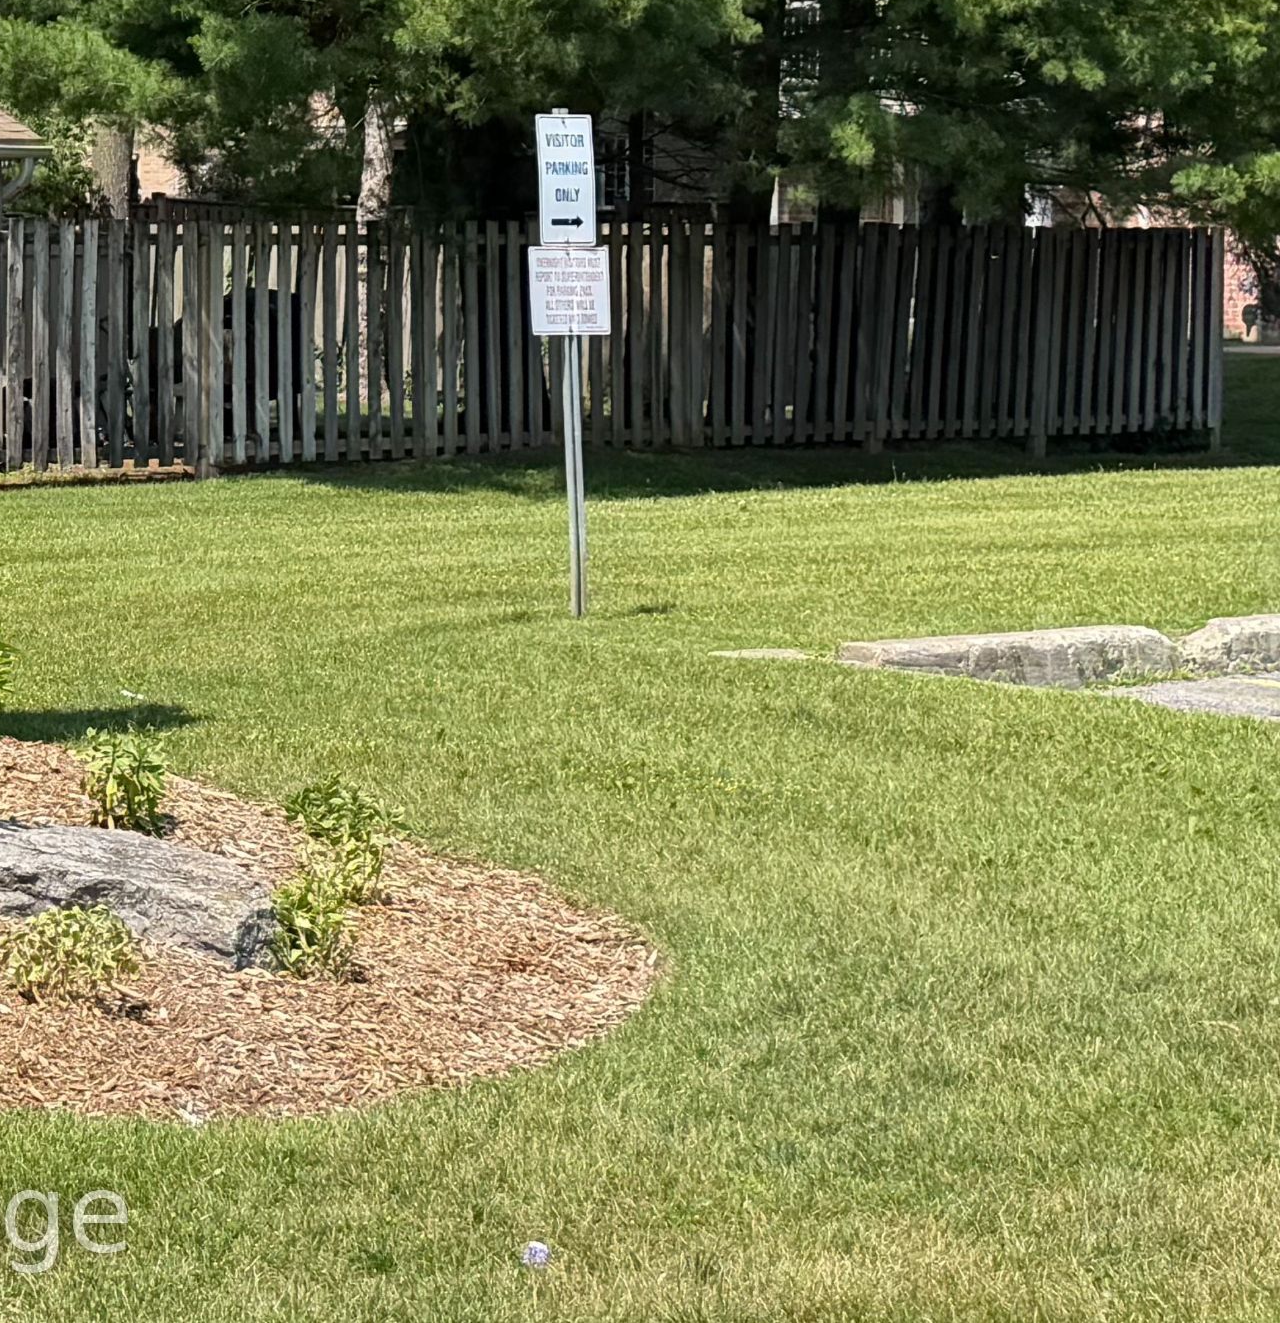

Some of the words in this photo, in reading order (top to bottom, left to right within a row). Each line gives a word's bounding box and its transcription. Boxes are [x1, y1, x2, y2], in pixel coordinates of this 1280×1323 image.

[545, 133, 585, 148] VISITOR
[545, 161, 589, 176] PARKING
[555, 188, 580, 203] ONLY
